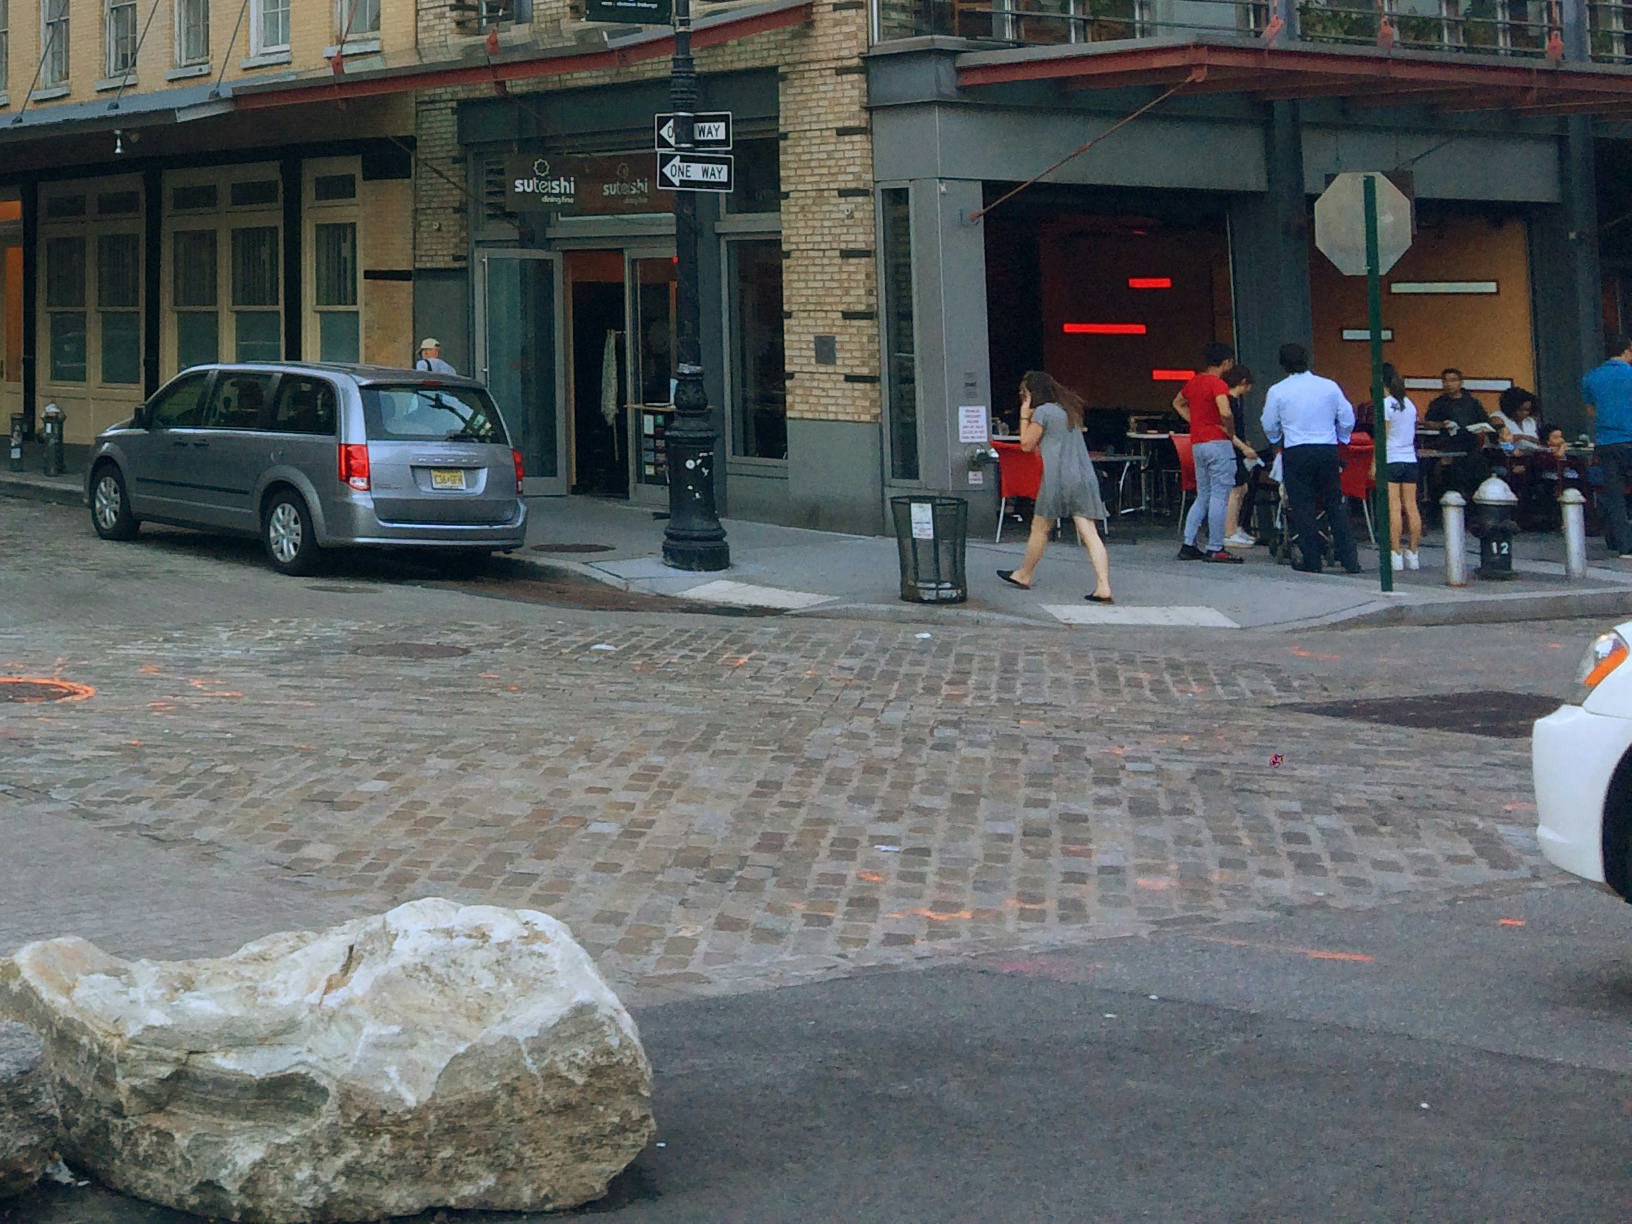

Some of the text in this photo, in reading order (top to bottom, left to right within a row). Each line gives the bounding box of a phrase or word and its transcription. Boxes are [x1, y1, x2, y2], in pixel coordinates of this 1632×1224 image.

[697, 124, 720, 138] WAY
[670, 164, 723, 180] ONE WAY
[514, 176, 575, 194] suteishi
[603, 178, 648, 196] suteishi
[1492, 541, 1509, 554] 12
